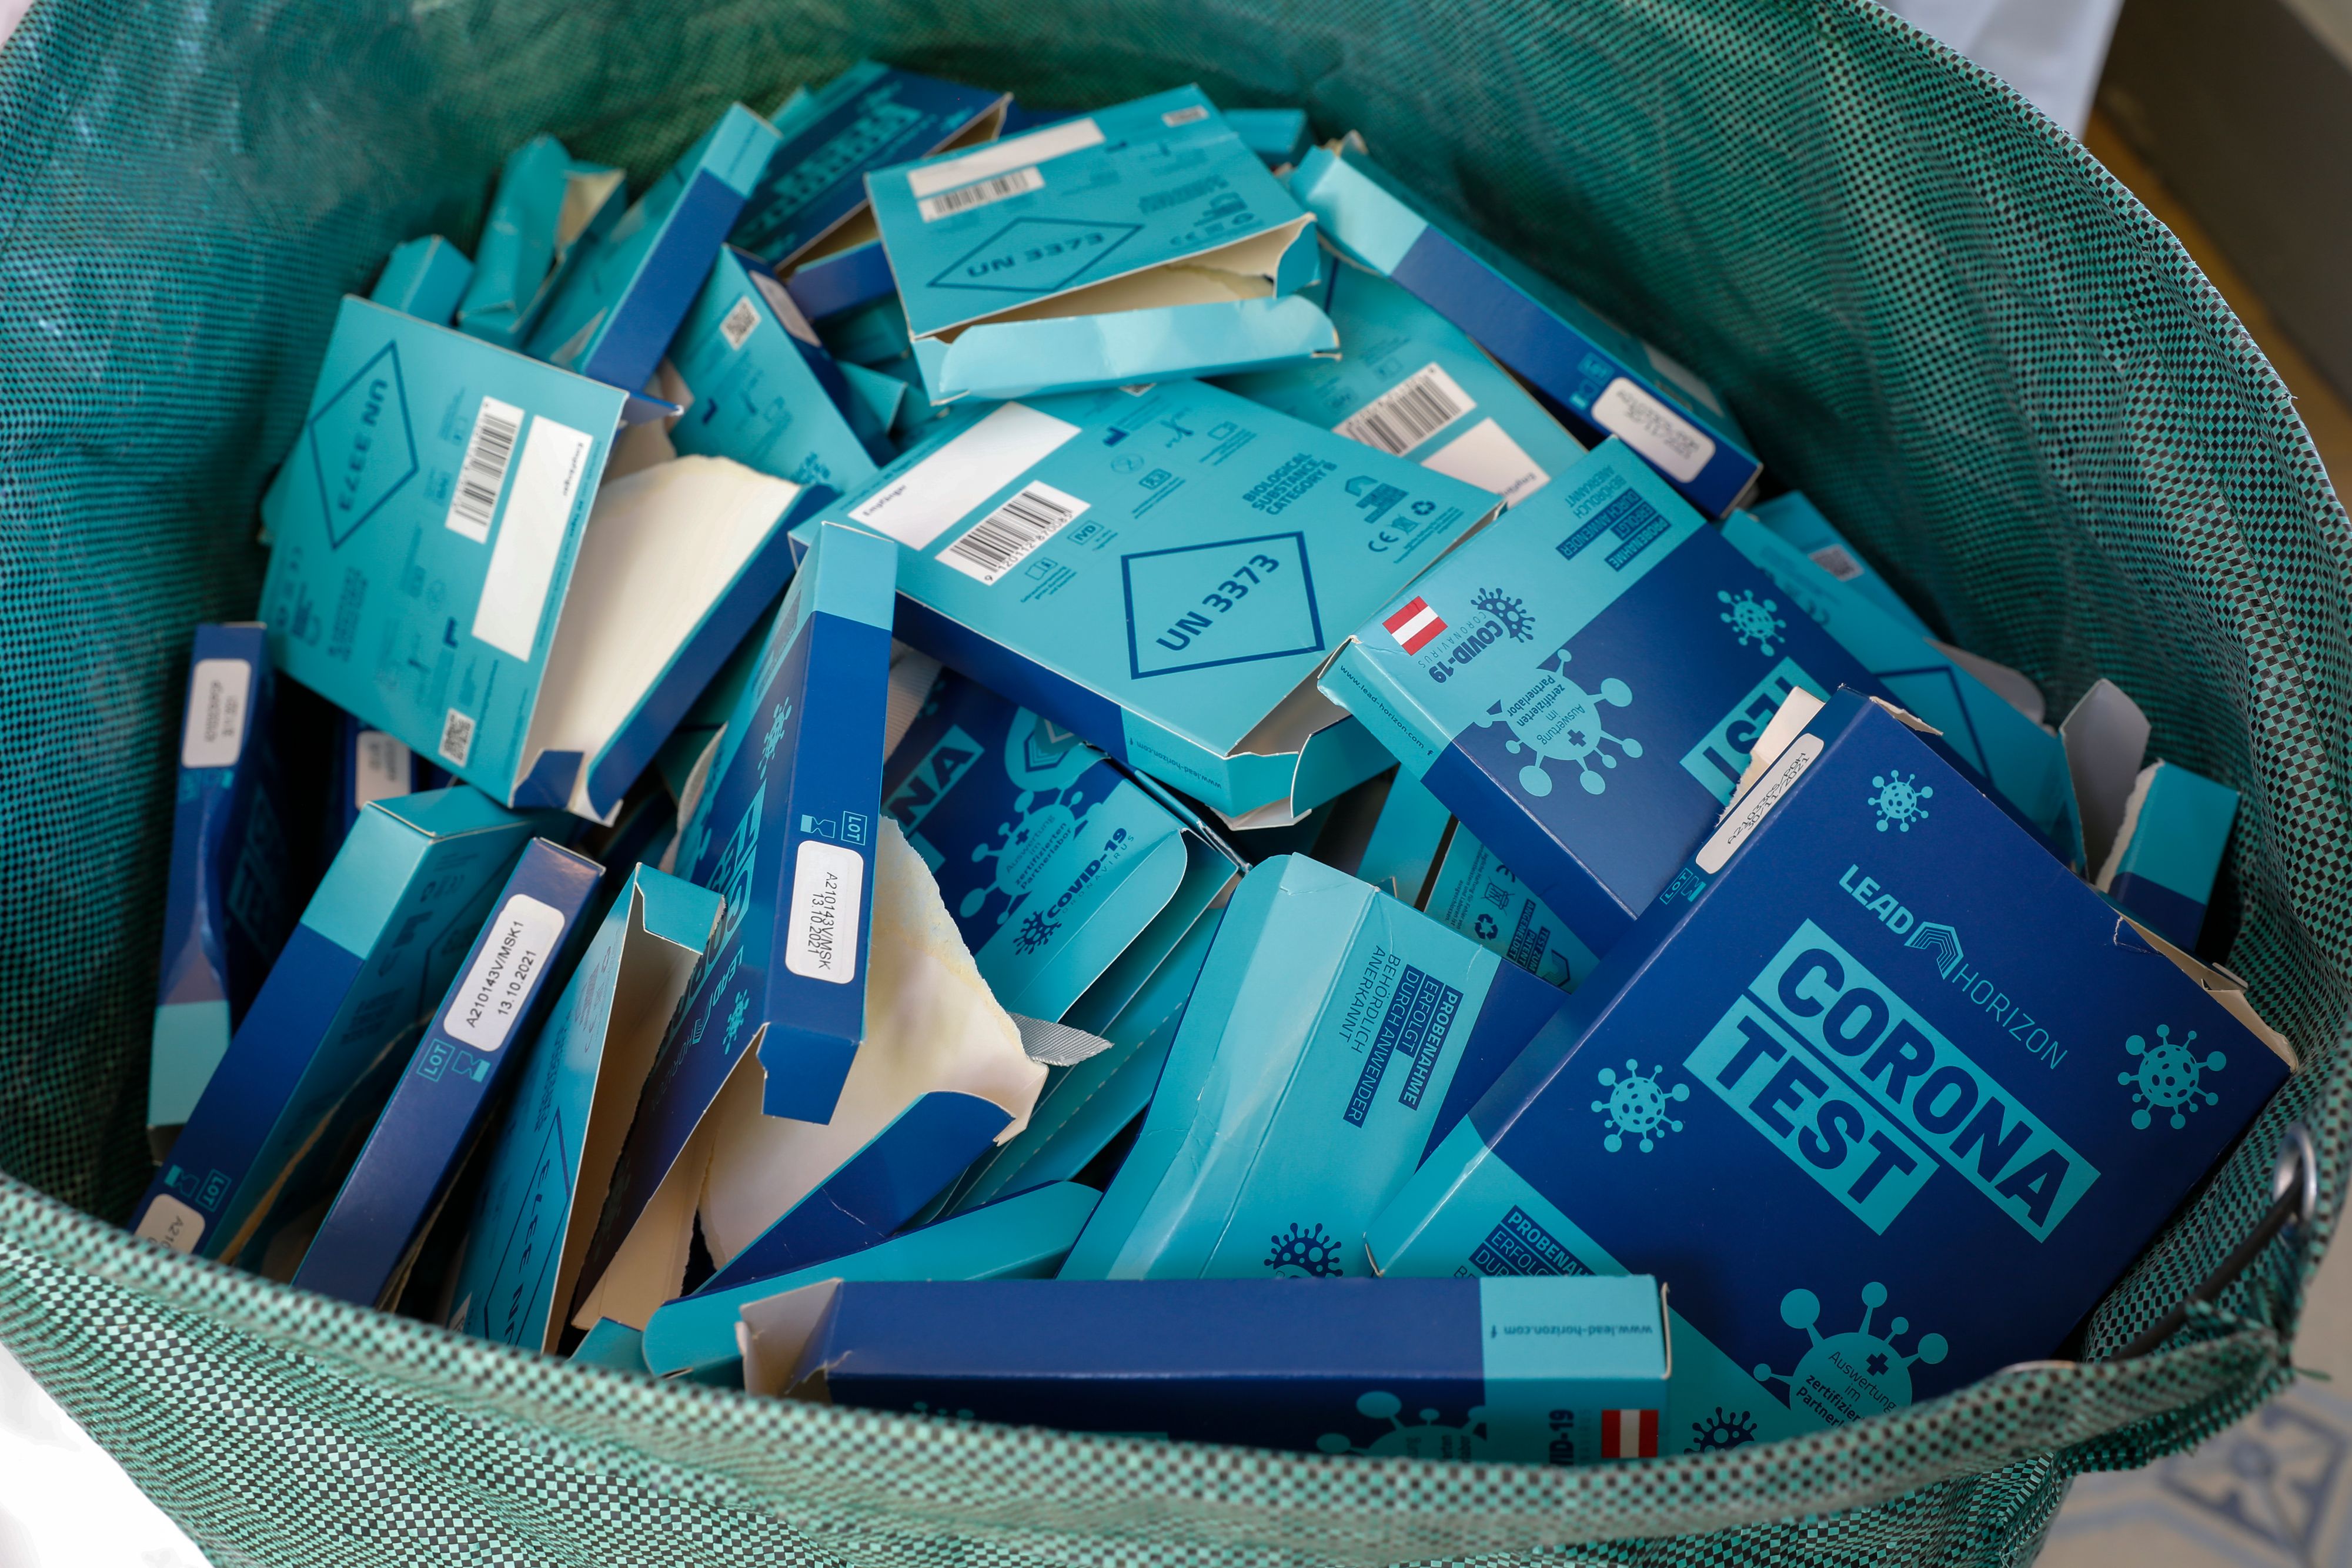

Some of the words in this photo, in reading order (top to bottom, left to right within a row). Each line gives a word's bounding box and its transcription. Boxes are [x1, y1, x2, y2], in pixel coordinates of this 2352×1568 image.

[967, 255, 1015, 278] UN
[1024, 232, 1104, 262] 3373
[362, 379, 387, 426] UN
[338, 434, 370, 511] 3373
[1242, 453, 1312, 502] BIOLOGICAL
[1265, 469, 1327, 515] CATEGORY
[1074, 524, 1096, 541] IVD
[1560, 514, 1611, 557] ANWENDER
[1609, 516, 1669, 568] PROBENAHME
[1617, 503, 1655, 538] ERFOLGT
[1156, 611, 1213, 651] UN
[1202, 554, 1280, 613] 3373
[1418, 612, 1487, 668] CORONAVIRUS
[1429, 620, 1504, 683] COVID-19
[1340, 665, 1424, 750] www.lead-horizon.com
[1508, 674, 1556, 717] Partnerlabor
[1516, 684, 1565, 727] zertifizierten
[1546, 710, 1559, 722] im
[1536, 704, 1586, 746] Auswertung
[1137, 741, 1221, 789] www.lead-horizon.com
[1745, 757, 1810, 830] 30/11/2021
[847, 817, 860, 841] LOT
[1006, 814, 1055, 874] Auswertung
[1028, 842, 1042, 857] im
[1015, 823, 1067, 886] zertifizierten
[1021, 827, 1073, 890] Partnerlabor
[1047, 827, 1128, 921] COVID-19
[1443, 880, 1464, 922] ausgeschlossen.
[1453, 896, 1465, 918] Laboren
[1468, 871, 1482, 894] Haftung
[1665, 873, 1687, 900] LOT
[807, 893, 824, 955] 13.10.2021
[818, 872, 838, 971] A210143V/MSK
[1459, 902, 1470, 920] Fehler
[1507, 900, 1535, 959] ANGEMELDET
[1517, 931, 1536, 965] PATENT
[1528, 950, 1541, 971] ZUM
[1535, 929, 1549, 950] TEST
[467, 921, 524, 1028] A210143V/MSK1
[498, 950, 536, 1015] 13.10.2021
[713, 945, 743, 1007] LEAD
[1838, 865, 1914, 935] LEAD
[1952, 963, 2068, 1070] HORIZON
[1339, 945, 1385, 1042] ANERKANNT
[1351, 954, 1401, 1054] BEHÖRDLICH
[1387, 970, 1419, 1028] DURCH
[1402, 981, 1438, 1054] ERFOLGT
[425, 1045, 447, 1075] LOT
[1404, 991, 1458, 1105] PROBENAHME
[1348, 1026, 1394, 1121] ANWENDER
[1777, 948, 2070, 1228] CORONA
[1717, 1015, 1917, 1205] TEST
[203, 1177, 224, 1205] LOT
[519, 1159, 550, 1275] 3373
[1475, 1249, 1510, 1277] DUR
[1492, 1231, 1550, 1276] ERFOL
[1508, 1212, 1590, 1276] PROBENA
[1504, 1325, 1652, 1336] www.lead-horizon.com
[1796, 1386, 1845, 1427] Partner
[1805, 1375, 1862, 1422] zertifizier
[1828, 1351, 1896, 1414] Auswertung
[1844, 1383, 1861, 1402] im
